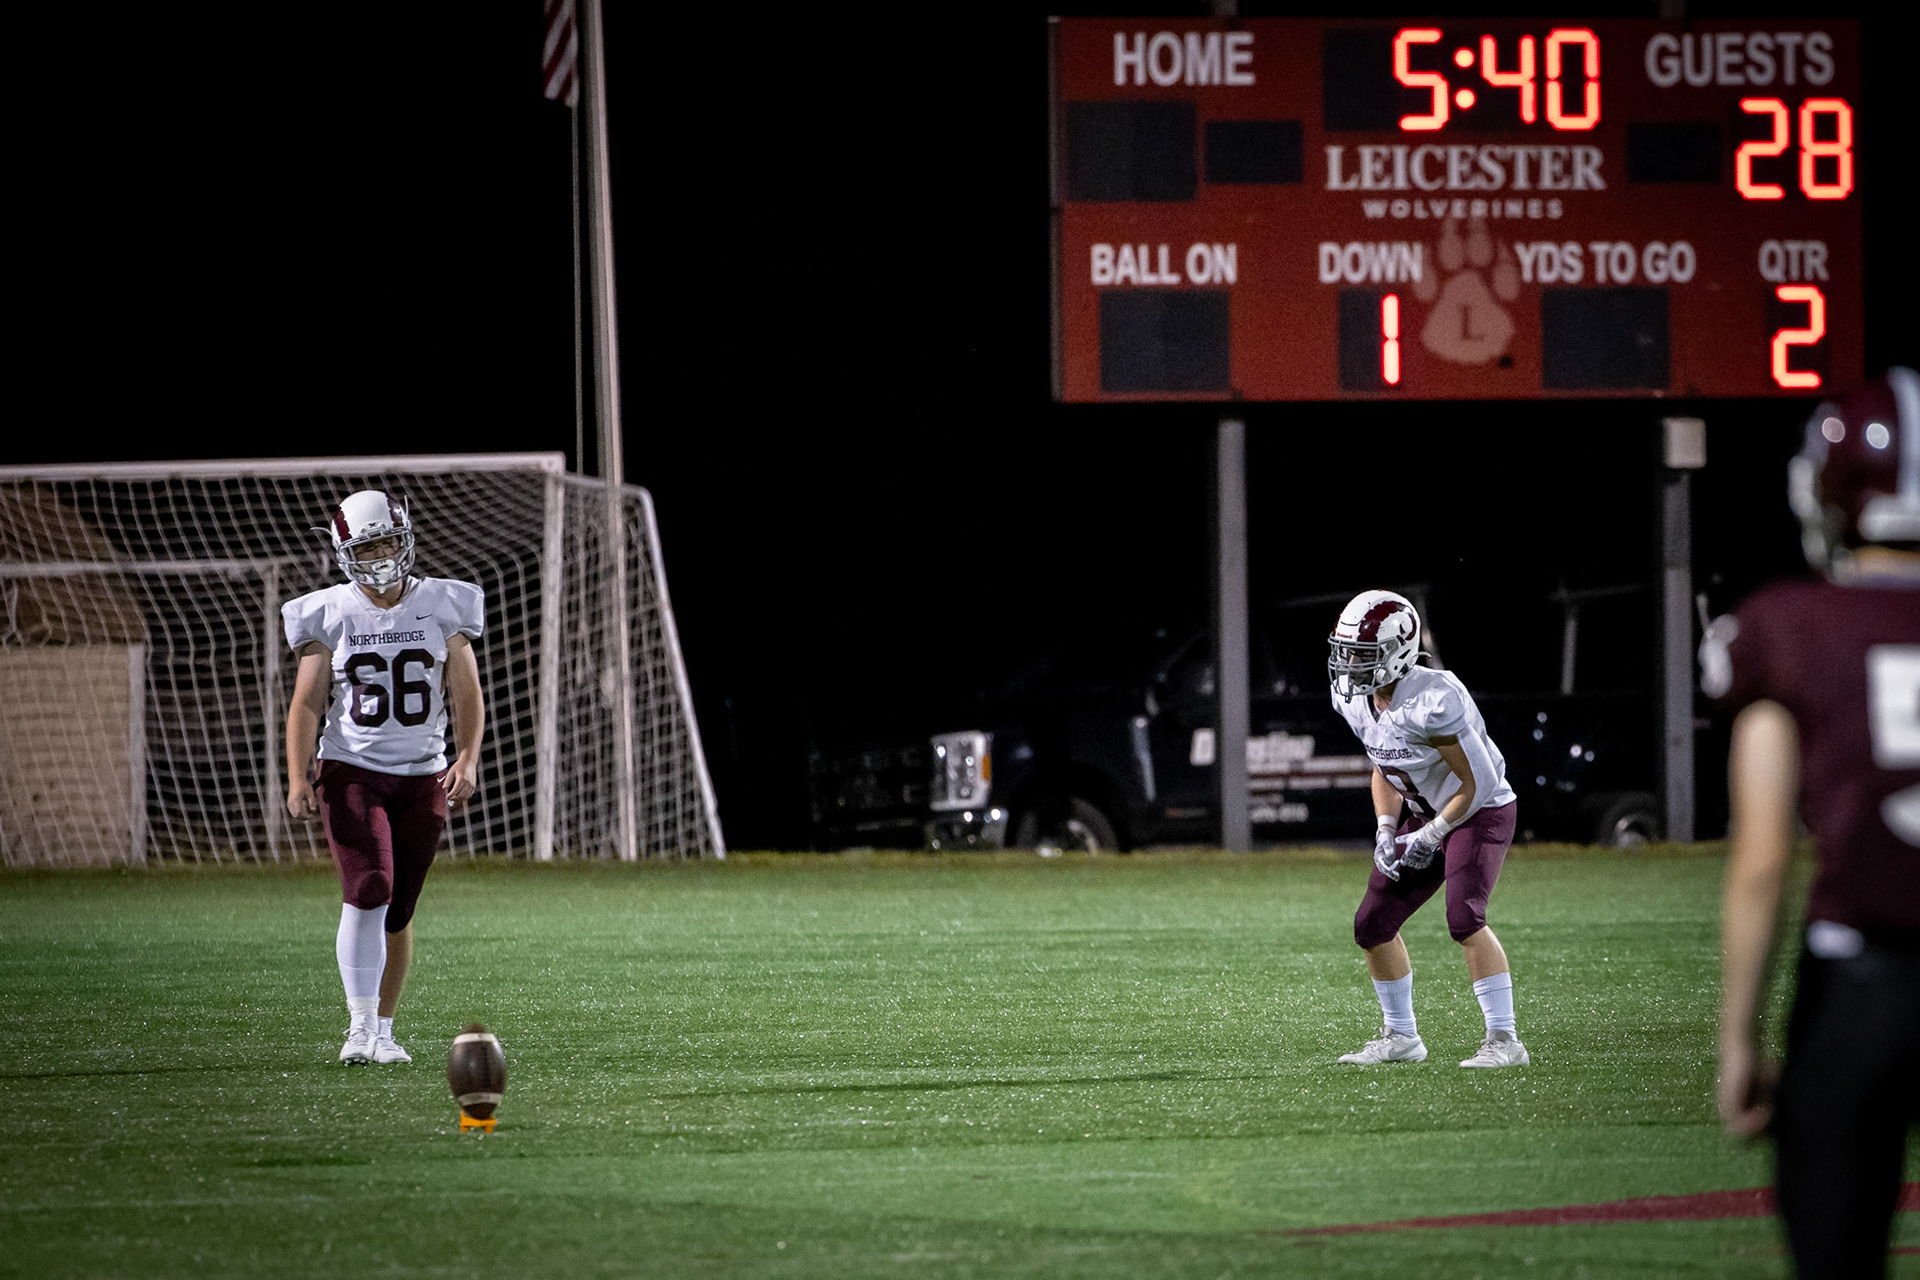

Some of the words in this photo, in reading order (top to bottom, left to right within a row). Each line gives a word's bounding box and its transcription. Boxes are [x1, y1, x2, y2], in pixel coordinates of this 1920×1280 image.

[1113, 31, 1255, 86] HOME
[1393, 27, 1601, 131] 5:40
[1645, 31, 1835, 87] GUESTS
[1325, 144, 1606, 191] LEICESTER
[1736, 98, 1854, 200] 28
[1363, 199, 1563, 220] WOLVERINES
[1091, 243, 1181, 286] BALL
[1186, 243, 1237, 286] ON
[1319, 241, 1423, 284] DOWN
[1514, 241, 1584, 285] YDS
[1589, 241, 1637, 285] TO
[1642, 241, 1697, 285] GO
[1758, 240, 1829, 283] QTR
[1381, 293, 1401, 386] 1
[1461, 306, 1485, 342] L
[1771, 285, 1826, 388] 2
[348, 630, 426, 647] NORTHBRIDGE
[343, 648, 436, 728] 66
